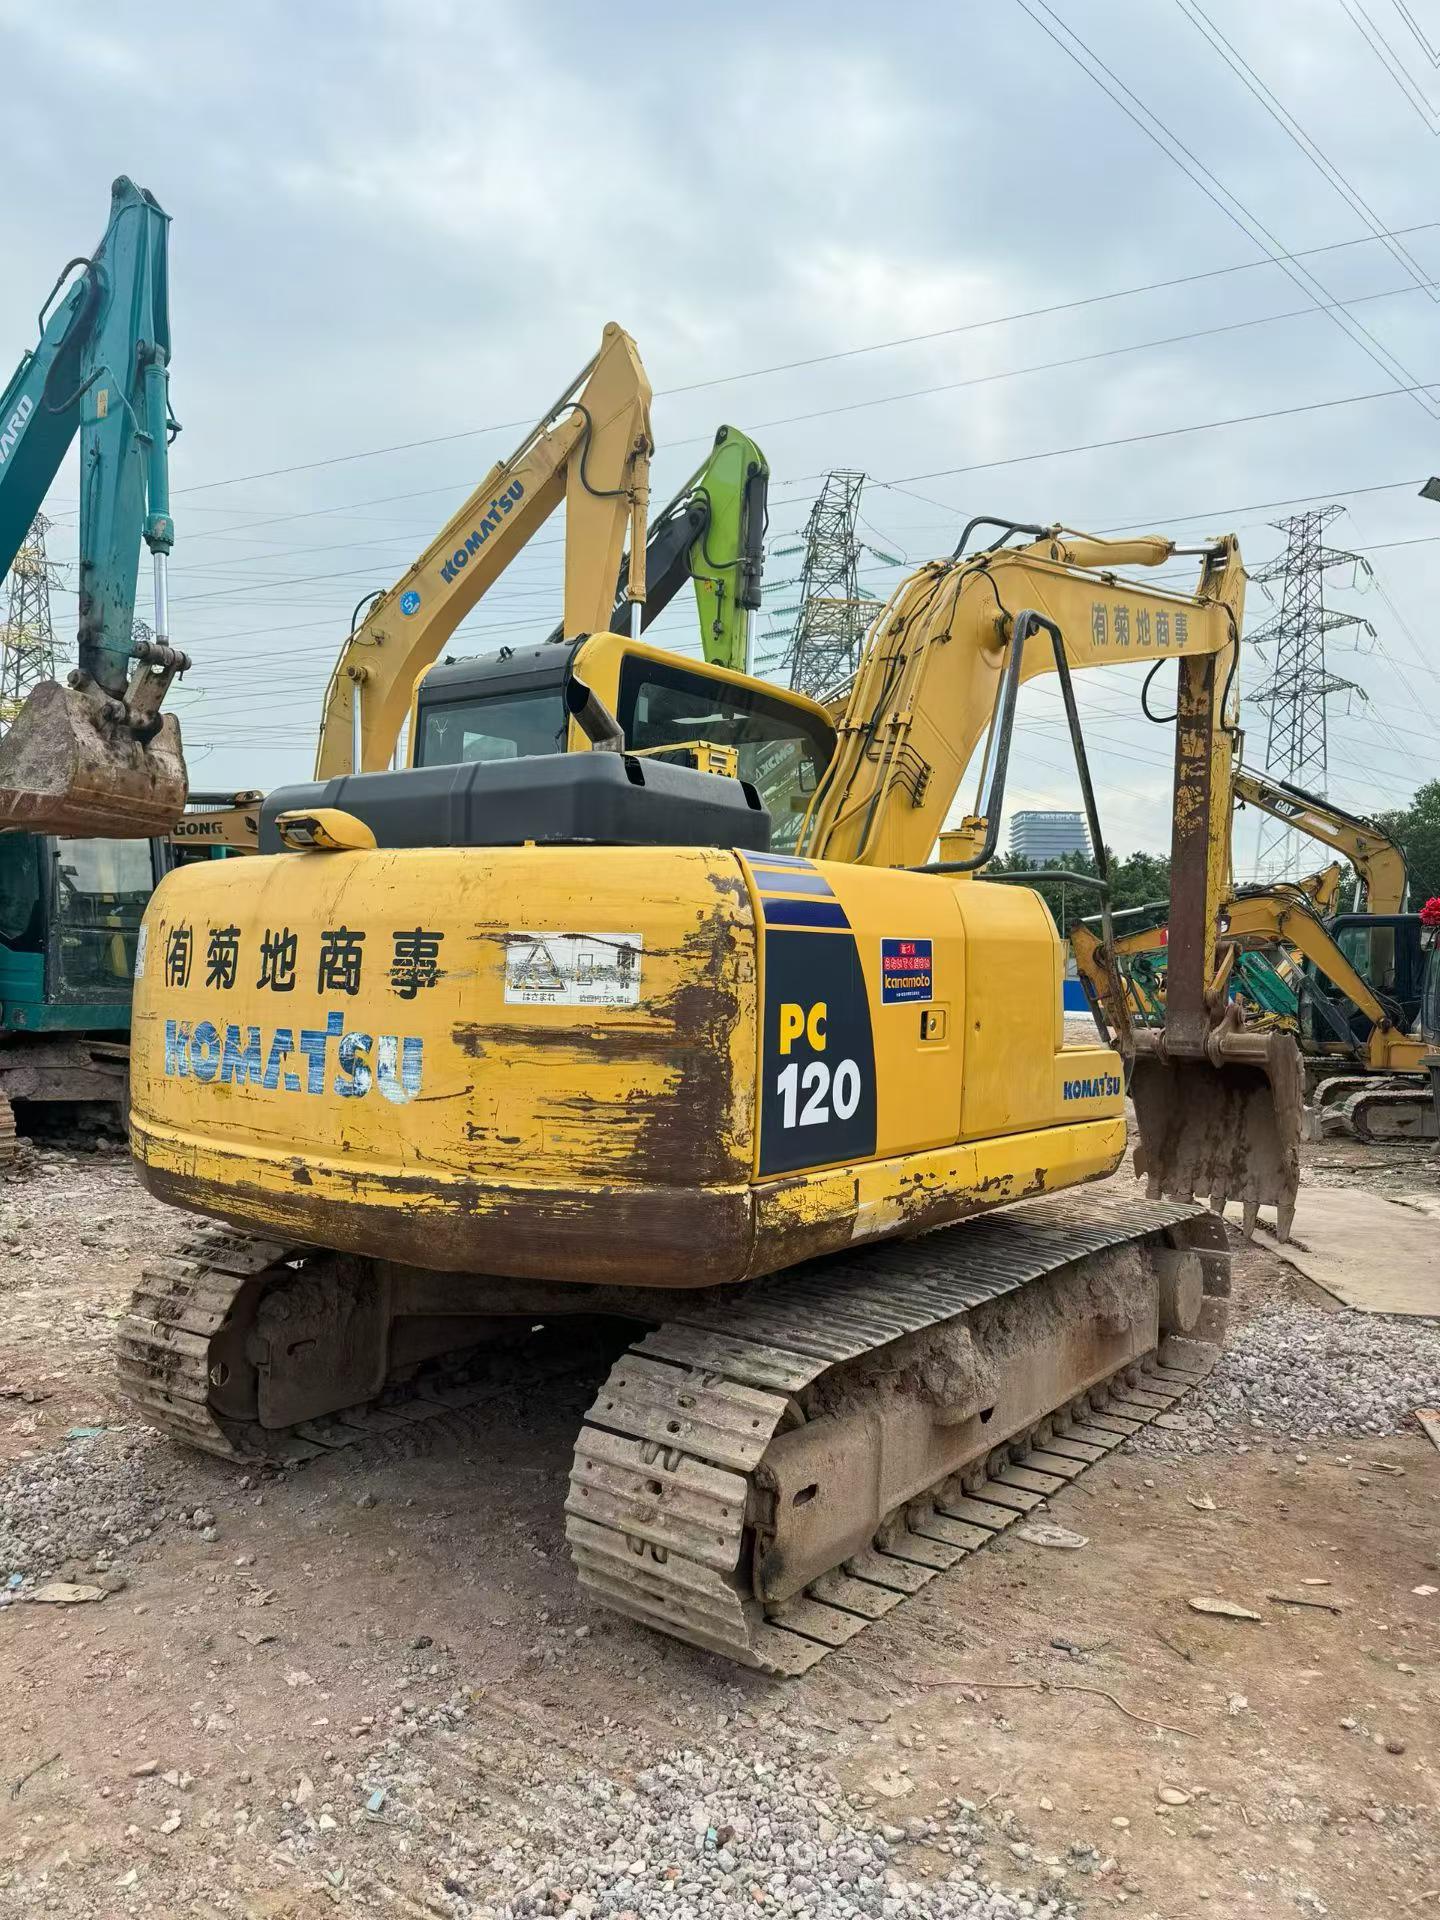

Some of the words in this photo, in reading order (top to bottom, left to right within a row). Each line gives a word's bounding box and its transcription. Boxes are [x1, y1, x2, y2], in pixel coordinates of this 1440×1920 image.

[440, 479, 524, 585] KOMATSU
[1274, 799, 1296, 816] CAT
[885, 973, 930, 988] kanamoto
[780, 1002, 827, 1055] PC
[164, 1011, 424, 1105] KOMATSU
[777, 1059, 861, 1129] 120
[1063, 1072, 1121, 1100] KOMATSU
